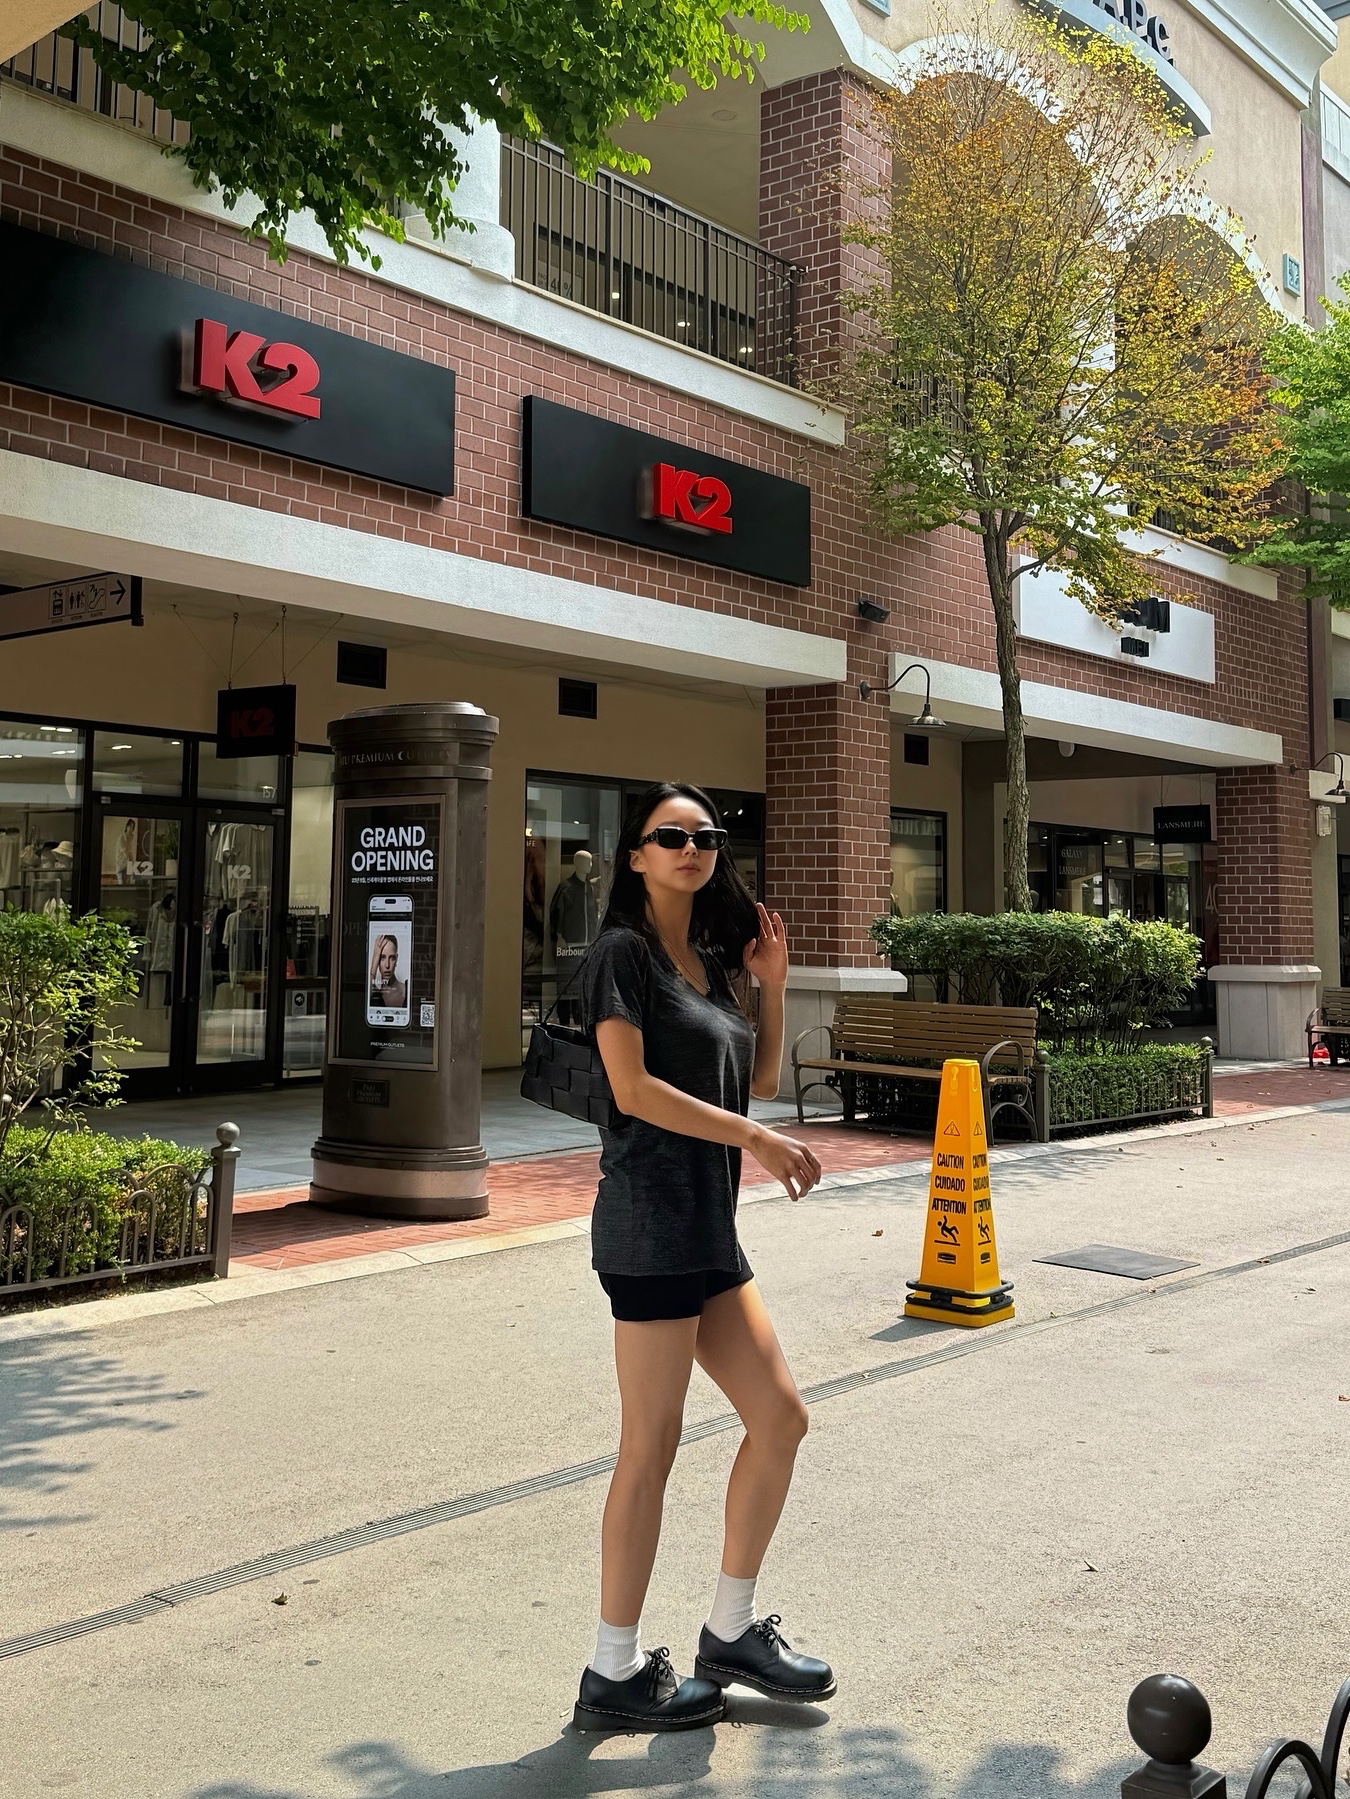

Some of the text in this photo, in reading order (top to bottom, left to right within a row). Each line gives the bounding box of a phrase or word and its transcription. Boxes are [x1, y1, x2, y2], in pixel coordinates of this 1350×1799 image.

[193, 318, 321, 420] K2
[653, 462, 733, 534] K2
[230, 708, 274, 737] K2
[262, 788, 276, 799] 157
[360, 825, 426, 848] GRAND
[127, 861, 154, 876] K2
[351, 849, 434, 872] OPENING
[227, 865, 251, 879] K2
[556, 946, 585, 957] Barbour
[937, 1153, 964, 1169] CAUTION
[935, 1175, 965, 1192] CUIDADO
[931, 1198, 966, 1214] ATTENTION
